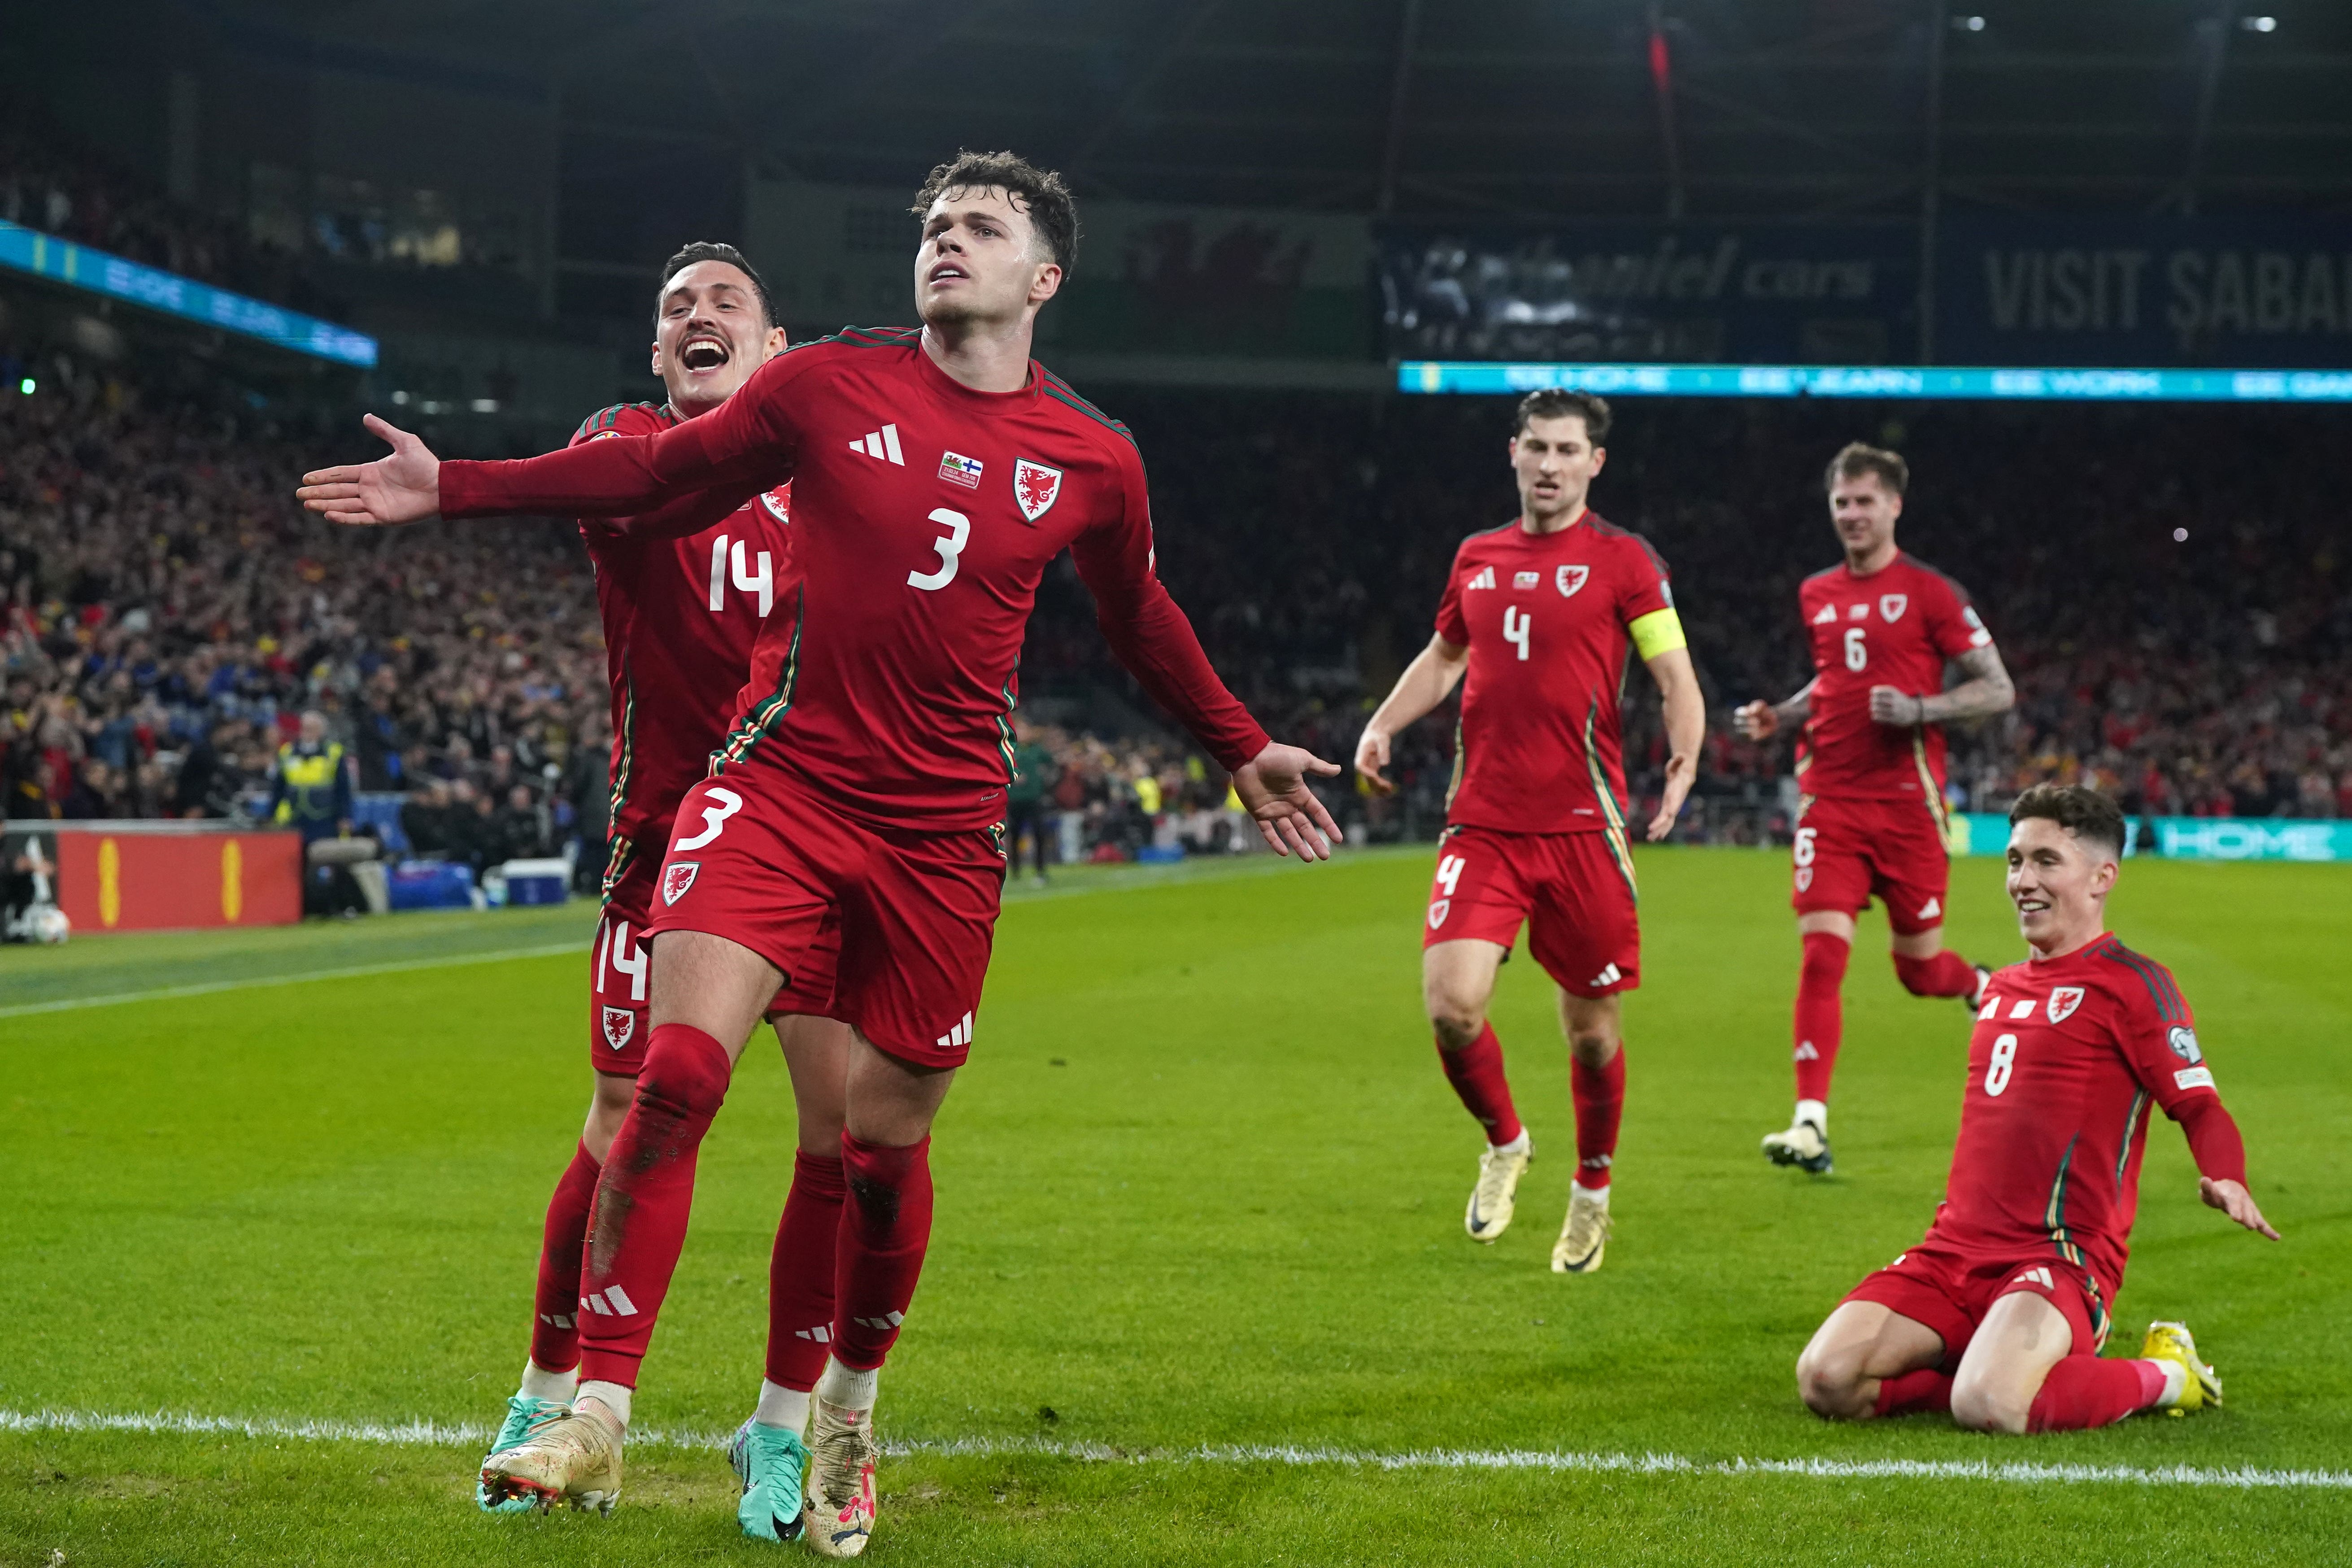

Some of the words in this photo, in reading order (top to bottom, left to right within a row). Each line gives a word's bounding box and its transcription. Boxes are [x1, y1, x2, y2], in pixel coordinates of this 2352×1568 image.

[1743, 258, 1873, 297] cars
[1984, 249, 2147, 331] VISIT
[2167, 250, 2352, 332] SABA
[710, 534, 773, 617] 14
[907, 508, 971, 591] 3
[1503, 605, 1531, 661] 4
[1844, 627, 1867, 672] 6
[674, 787, 743, 852] 3
[1794, 827, 1817, 867] 6
[2163, 823, 2334, 861] HOME
[1436, 854, 1466, 896] 4
[596, 916, 648, 1001] 14
[1984, 1033, 2018, 1097] 8
